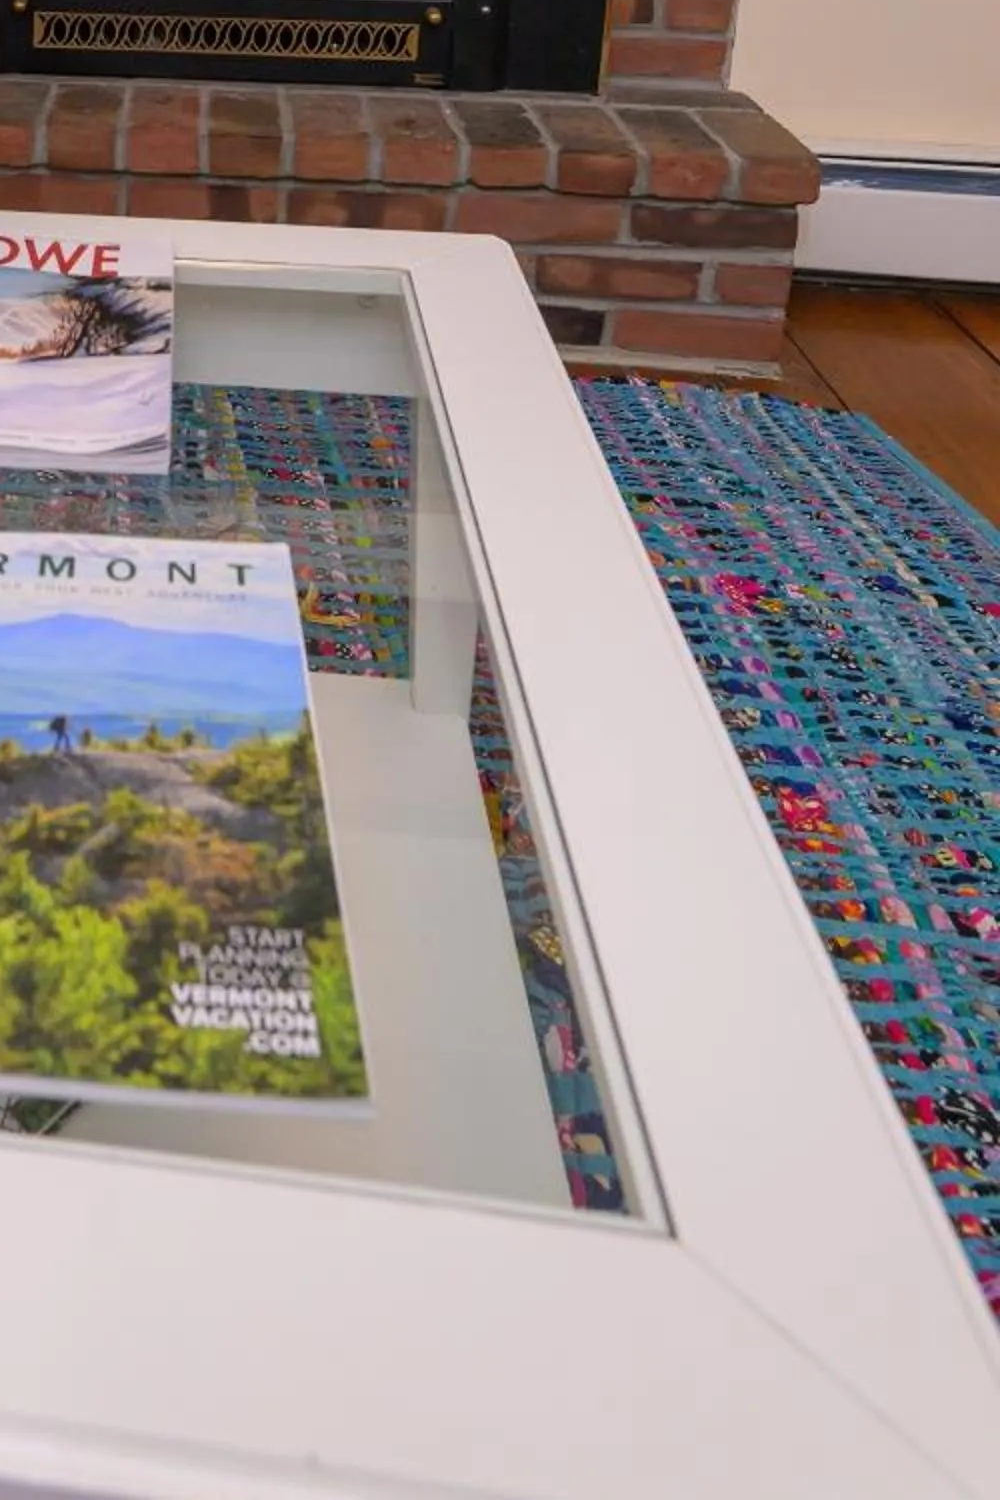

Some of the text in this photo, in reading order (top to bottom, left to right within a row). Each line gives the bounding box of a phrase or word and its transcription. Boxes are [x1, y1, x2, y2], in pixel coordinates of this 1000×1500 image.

[229, 925, 304, 947] START
[170, 980, 313, 1012] VERMONT
[171, 1004, 318, 1034] VACATION
[243, 1030, 321, 1059] .COM
